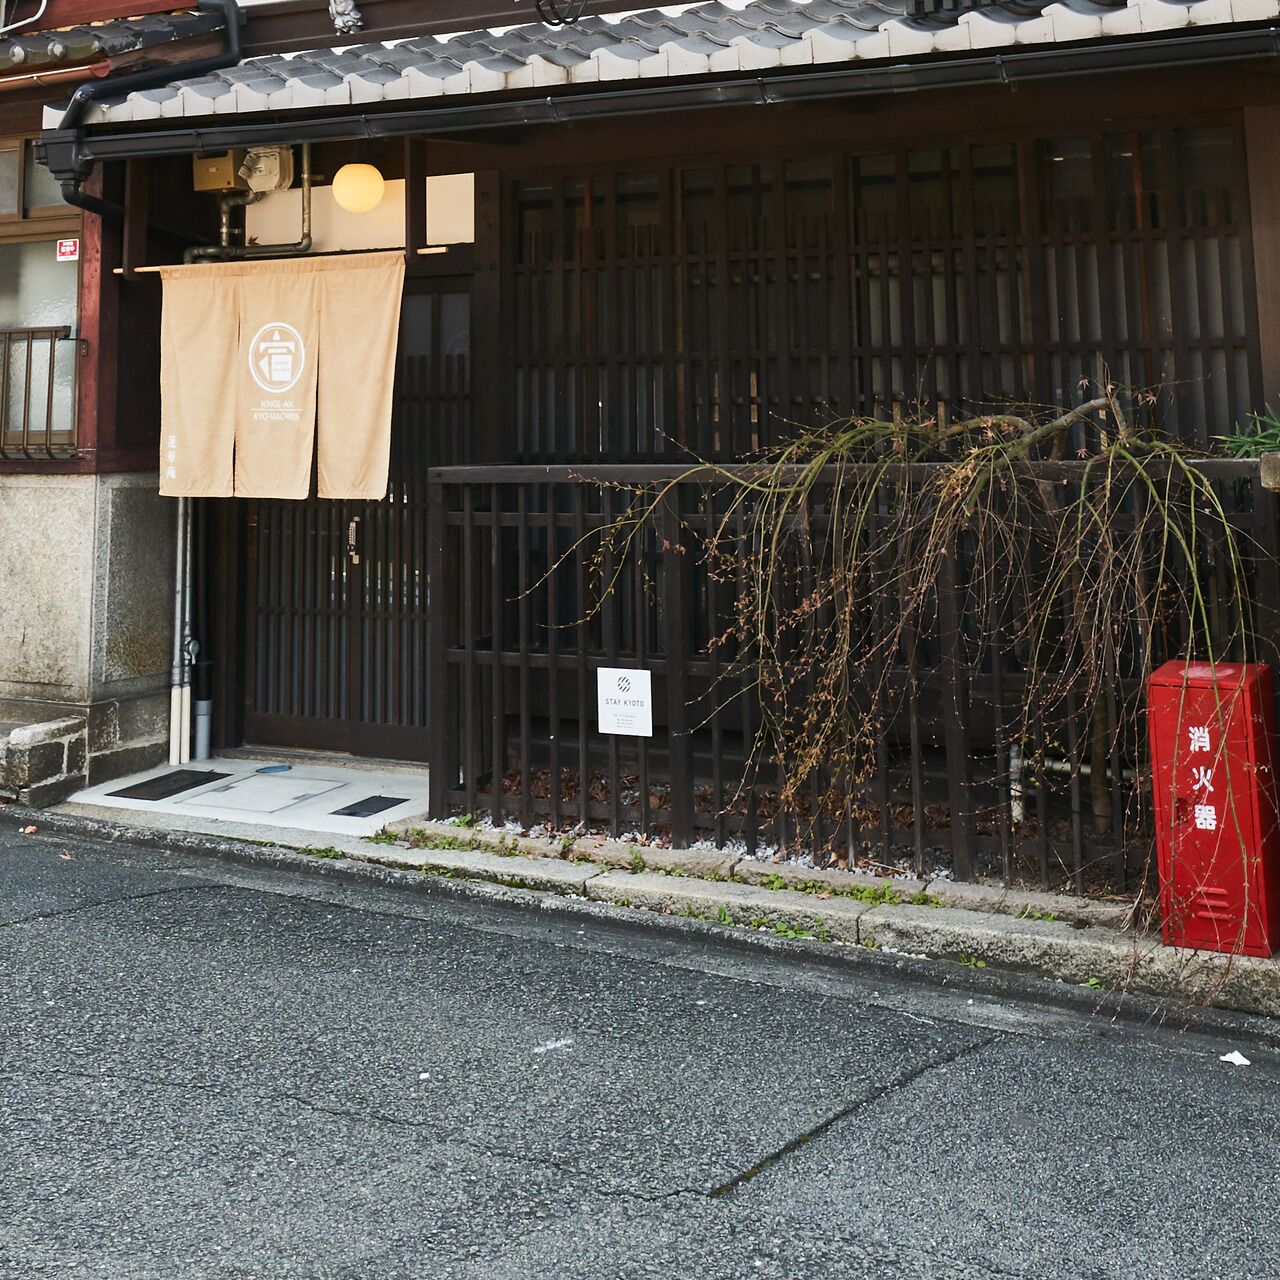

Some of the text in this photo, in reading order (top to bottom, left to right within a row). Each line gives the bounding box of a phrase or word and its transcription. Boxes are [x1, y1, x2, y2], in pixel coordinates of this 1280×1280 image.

[605, 697, 645, 708] STAY KYOTO
[1188, 725, 1218, 831] 消火器
